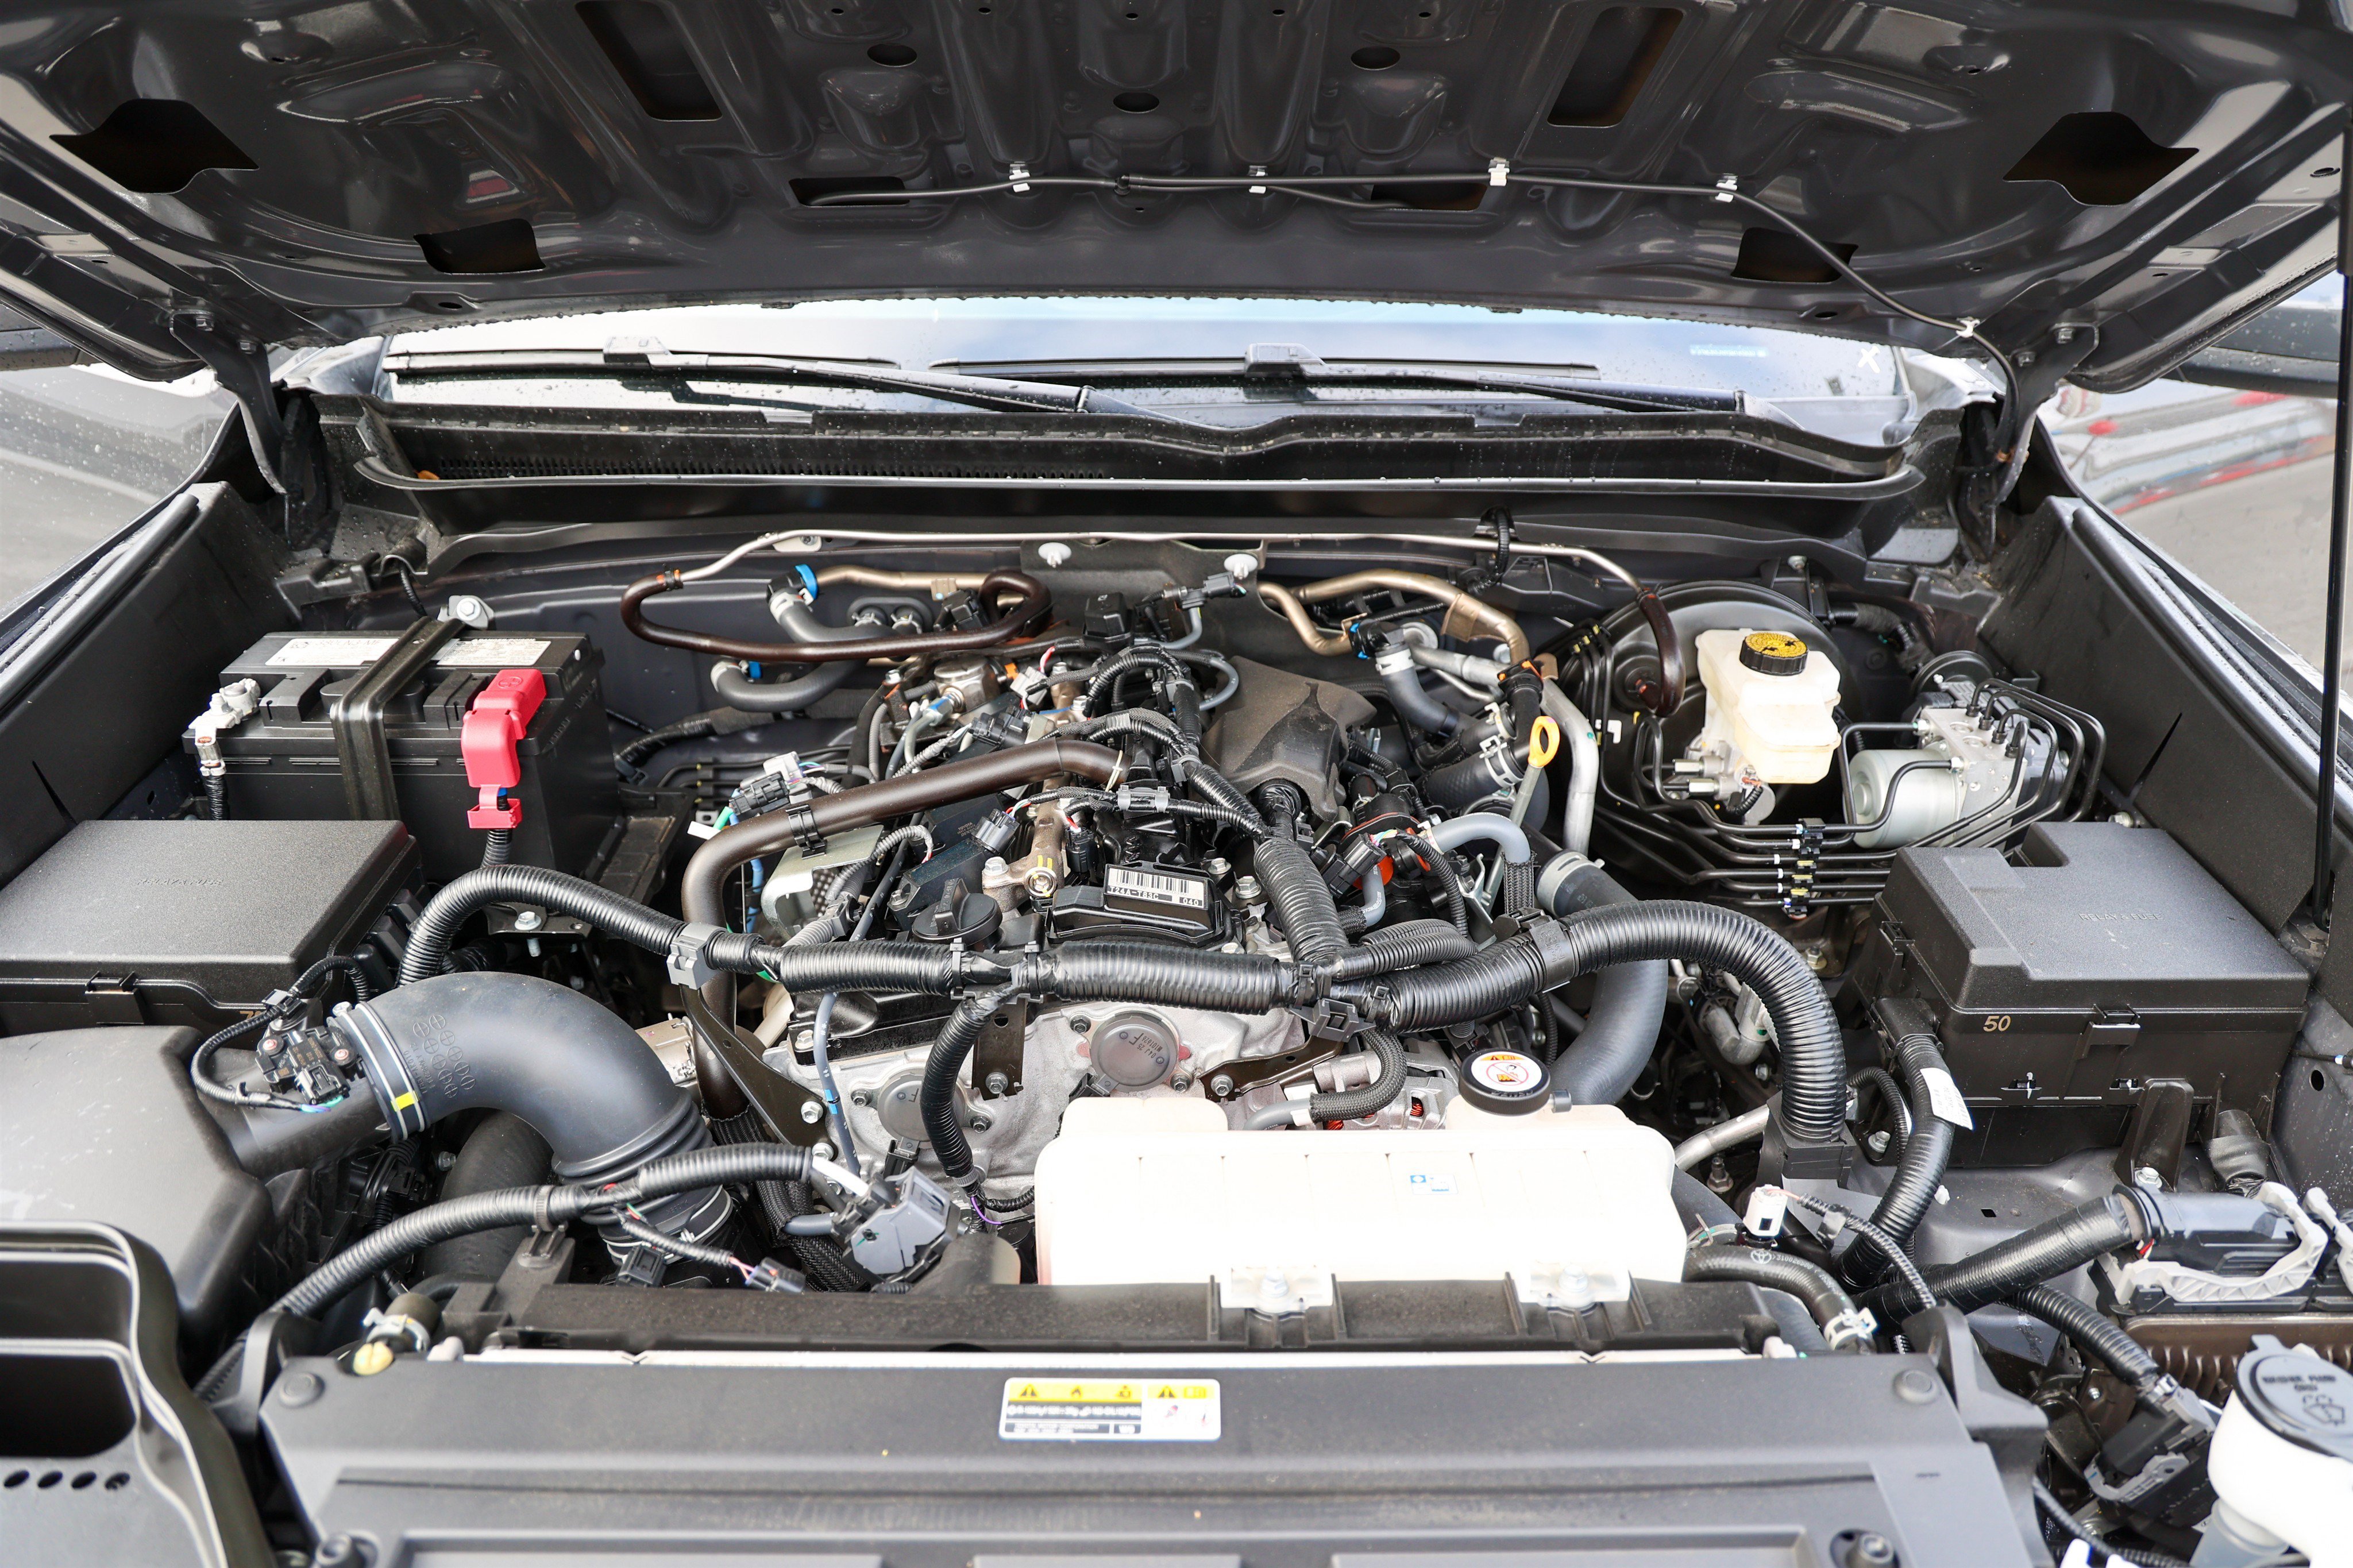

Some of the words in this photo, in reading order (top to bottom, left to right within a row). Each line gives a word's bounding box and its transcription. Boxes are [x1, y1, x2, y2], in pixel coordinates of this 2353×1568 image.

[958, 822, 973, 831] TOYOTA
[1110, 886, 1159, 900] T24A-T83C
[1182, 898, 1199, 906] 040
[1983, 1015, 2011, 1032] 50
[1129, 1033, 1144, 1045] F
[908, 1088, 919, 1103] F
